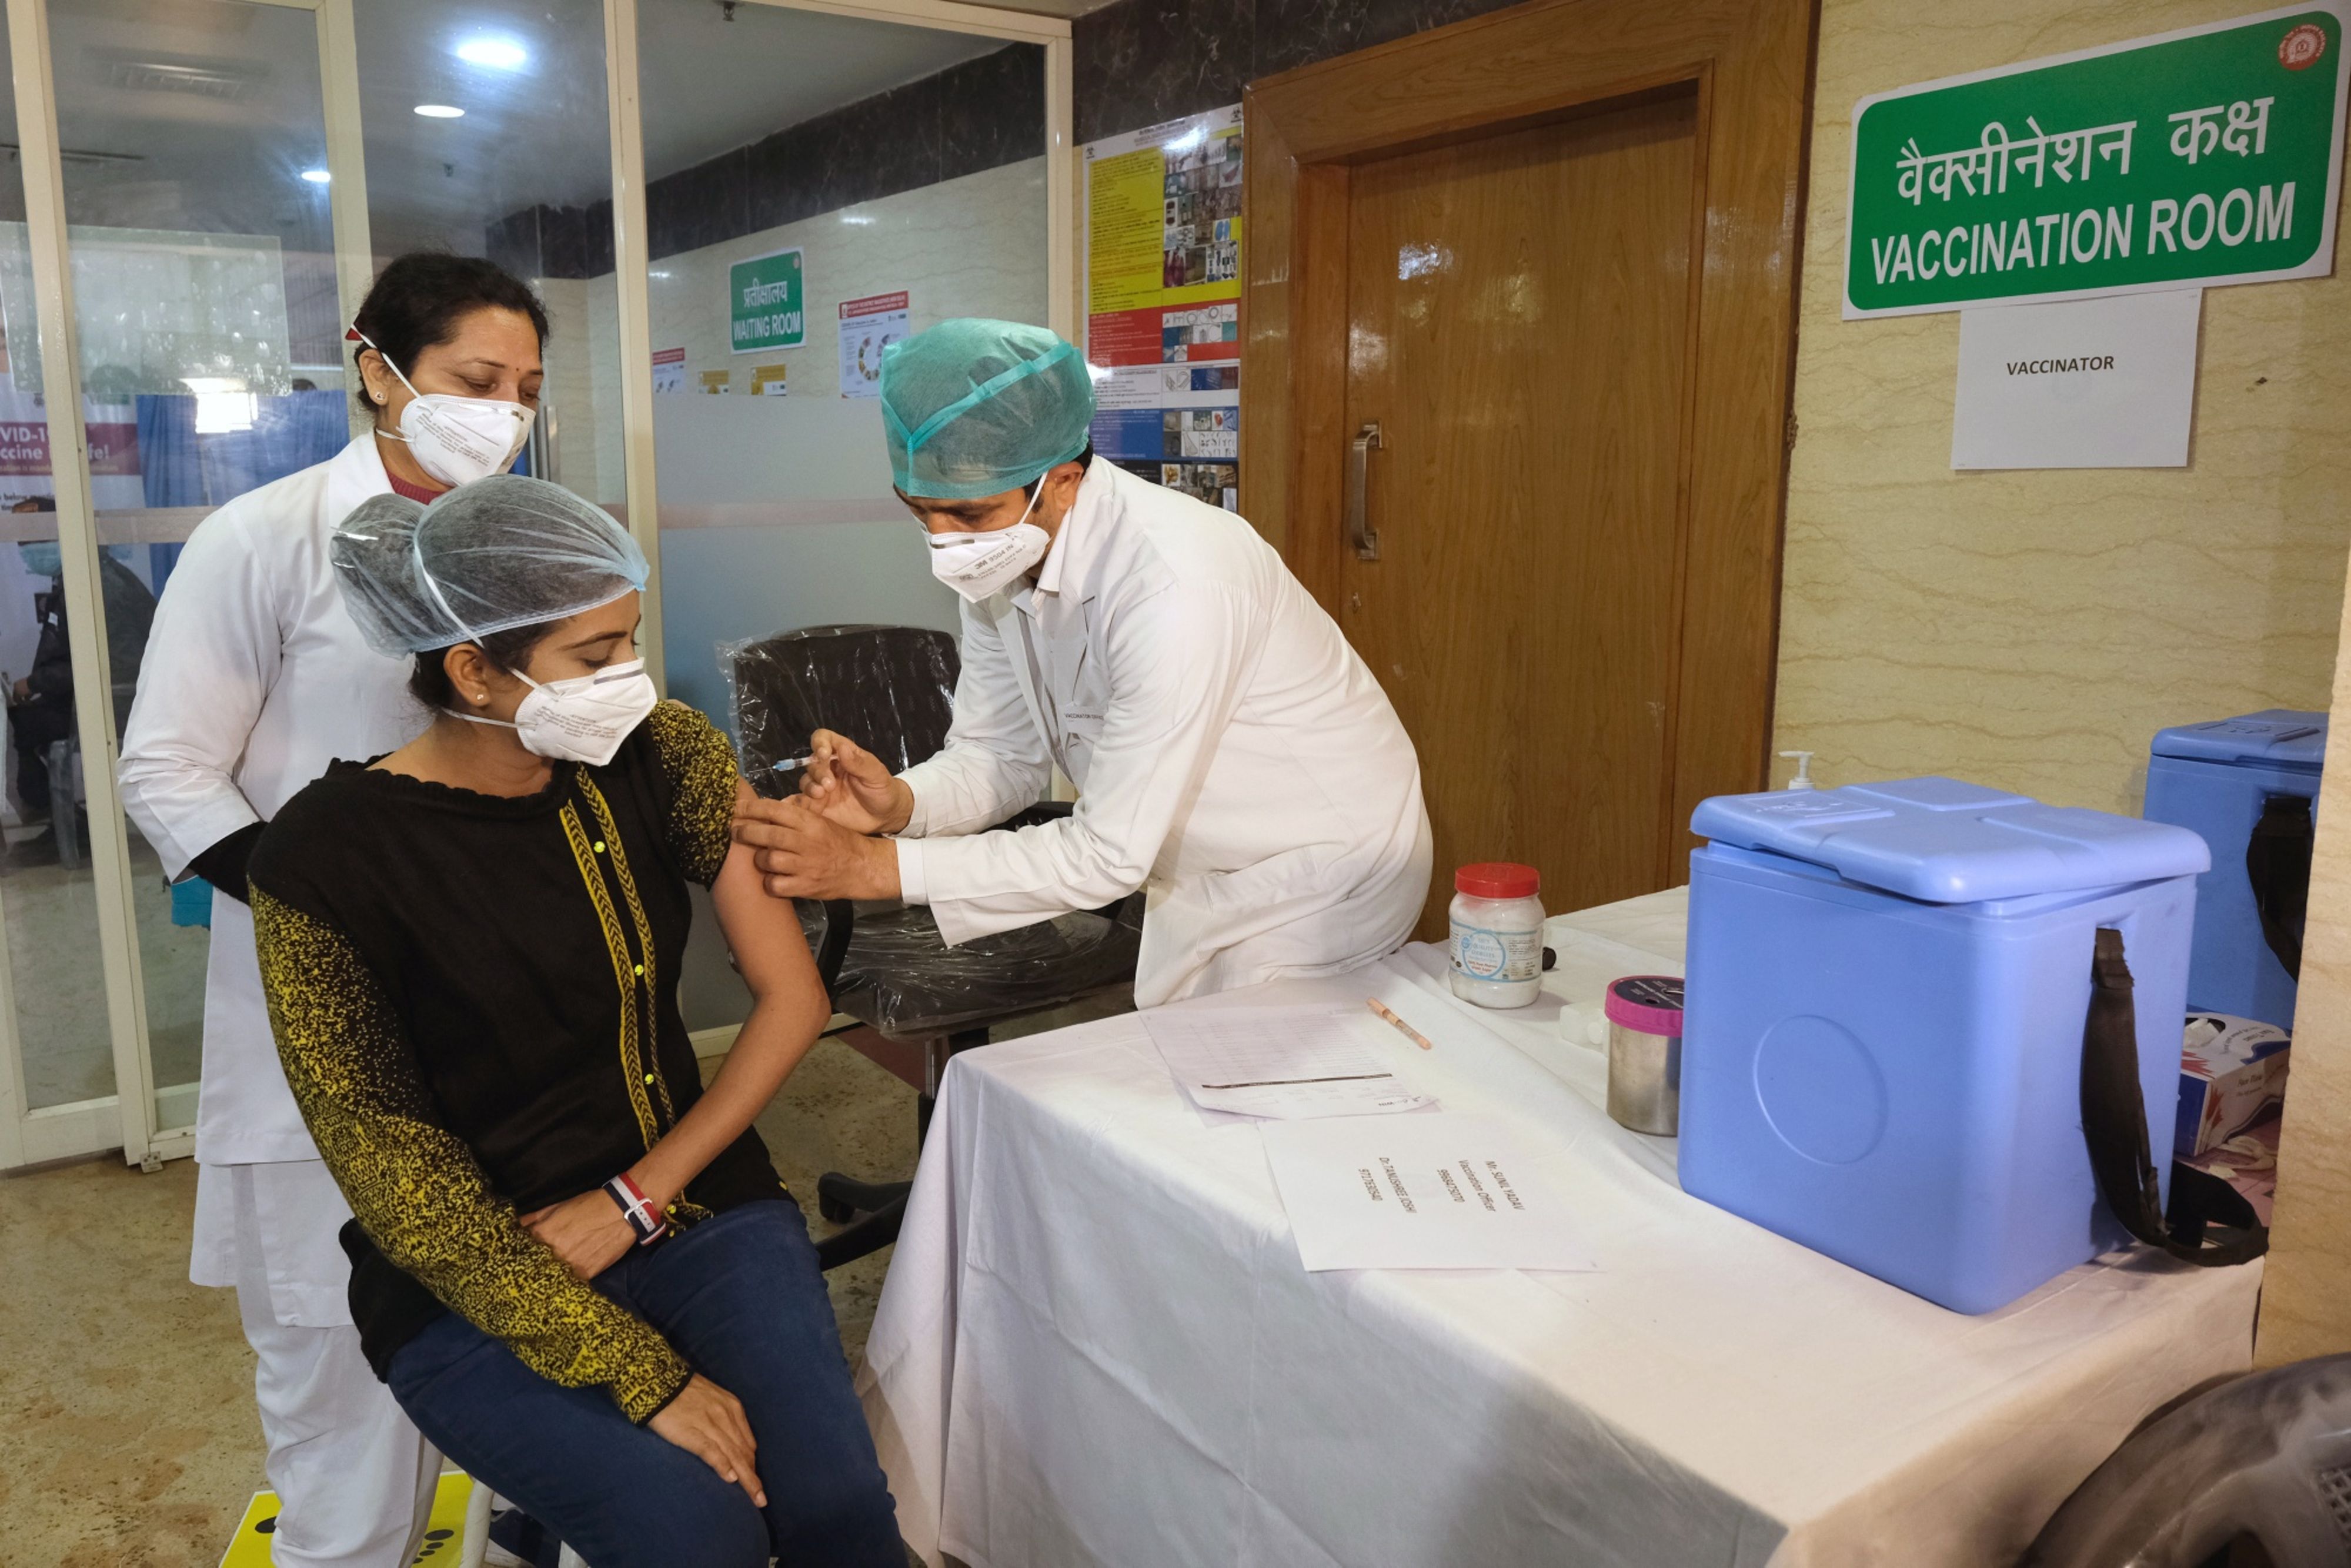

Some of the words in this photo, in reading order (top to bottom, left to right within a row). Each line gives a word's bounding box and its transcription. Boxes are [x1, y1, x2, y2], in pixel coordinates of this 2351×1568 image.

[1896, 116, 2137, 205] वैक्सीनेशन
[2168, 96, 2275, 165] कक्ष
[1871, 204, 2133, 285] VACCINATION
[2148, 182, 2296, 255] ROOM
[743, 278, 787, 308] प्रतीक्षालय
[733, 316, 770, 340] WAITING
[772, 311, 801, 336] ROOM
[2006, 356, 2115, 376] VACCINATOR
[0, 426, 49, 443] VID-1
[0, 444, 43, 460] ccine
[1458, 1159, 1484, 1191] Vaccination
[1477, 1192, 1497, 1212] Officer
[1484, 1161, 1497, 1171] Mr.
[1491, 1171, 1511, 1189] SUNIL
[1503, 1189, 1526, 1211] YADAV
